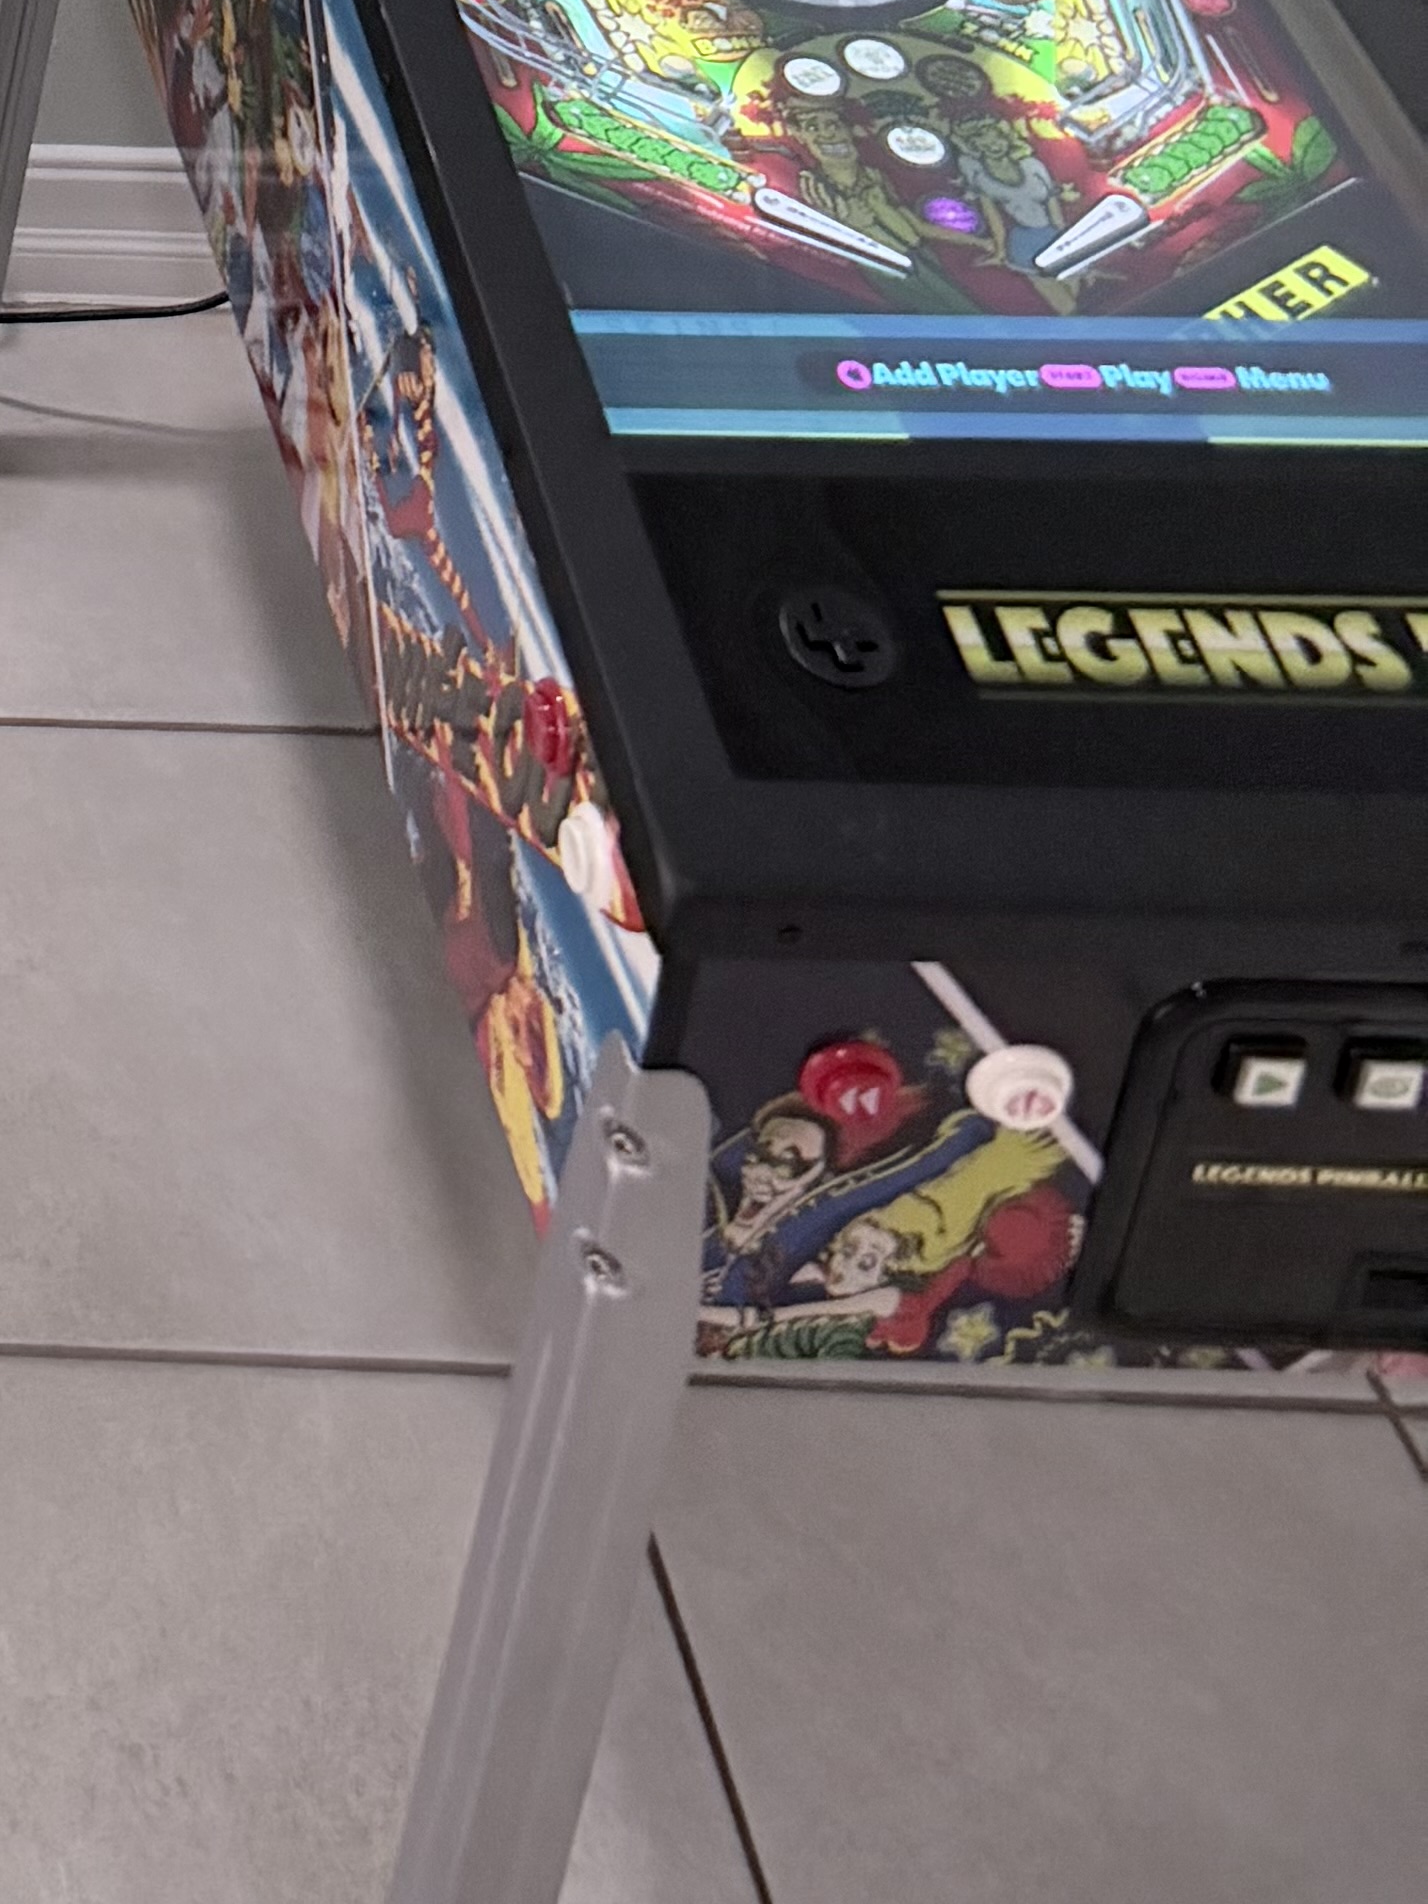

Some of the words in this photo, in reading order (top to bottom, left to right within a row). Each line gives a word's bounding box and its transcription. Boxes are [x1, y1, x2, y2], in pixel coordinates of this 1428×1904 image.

[872, 361, 938, 388] Add
[939, 362, 1041, 396] Player
[1100, 363, 1173, 398] Play
[1235, 366, 1331, 392] Menu
[942, 604, 1413, 692] LEGENDS
[1192, 1164, 1311, 1185] LEGENDS
